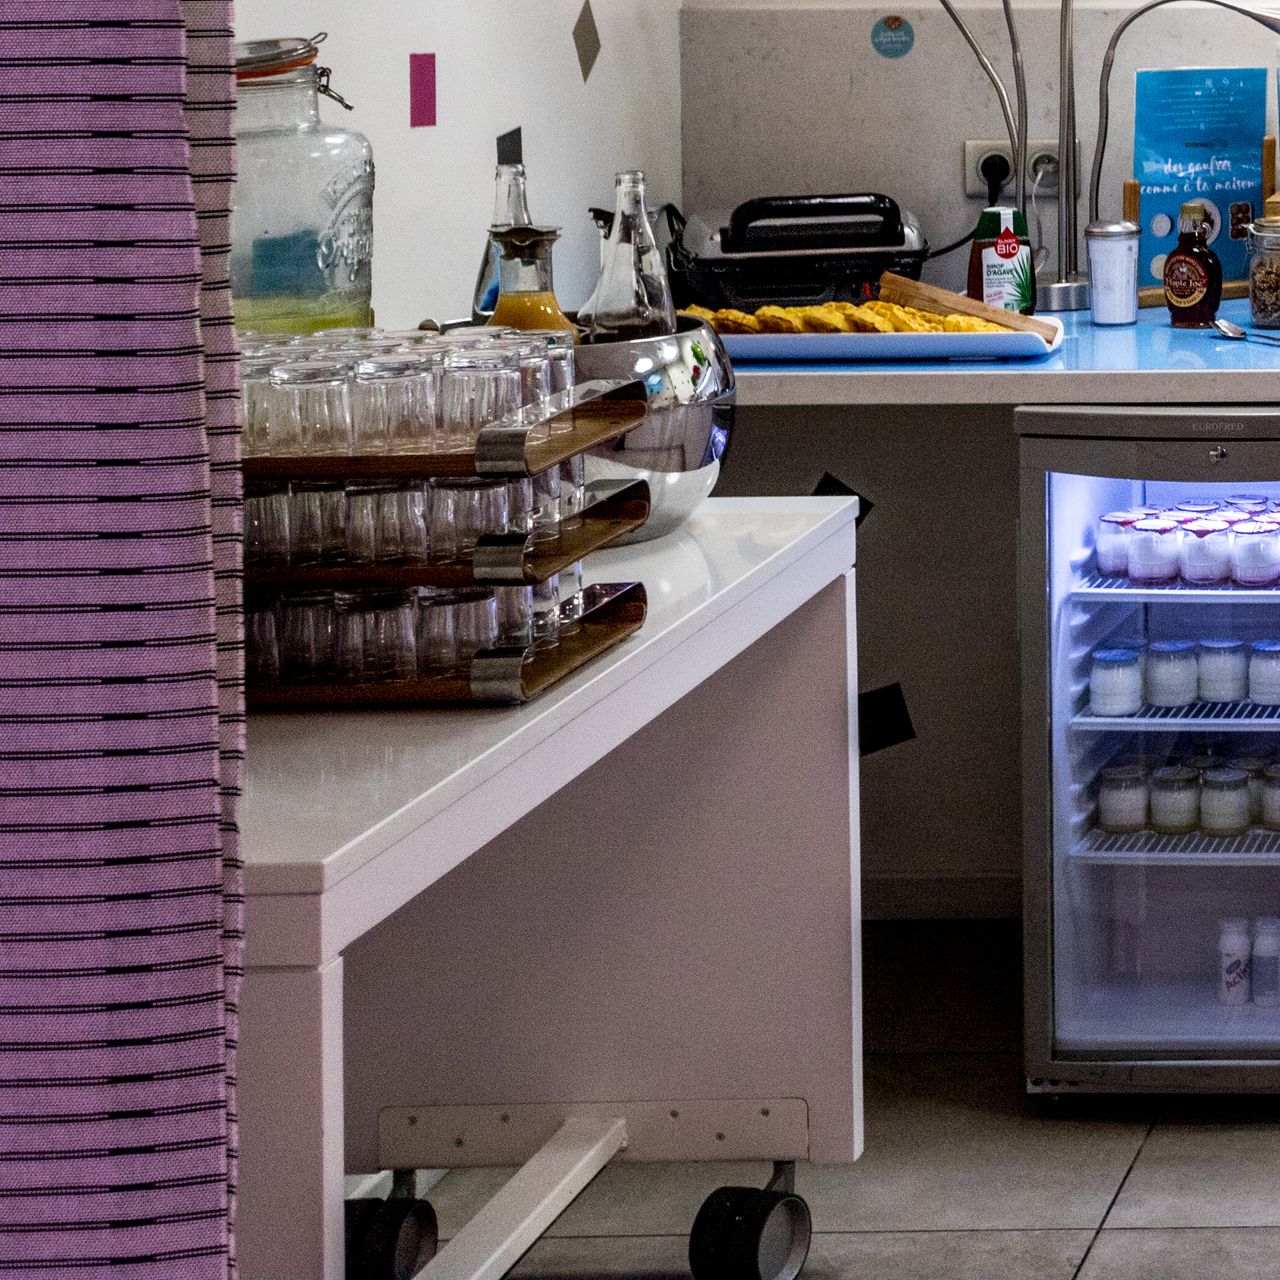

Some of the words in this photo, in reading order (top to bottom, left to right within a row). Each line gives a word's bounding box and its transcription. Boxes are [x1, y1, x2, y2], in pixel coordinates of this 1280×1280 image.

[1140, 183, 1178, 194] comme
[1196, 176, 1209, 192] la
[997, 243, 1018, 254] BIO
